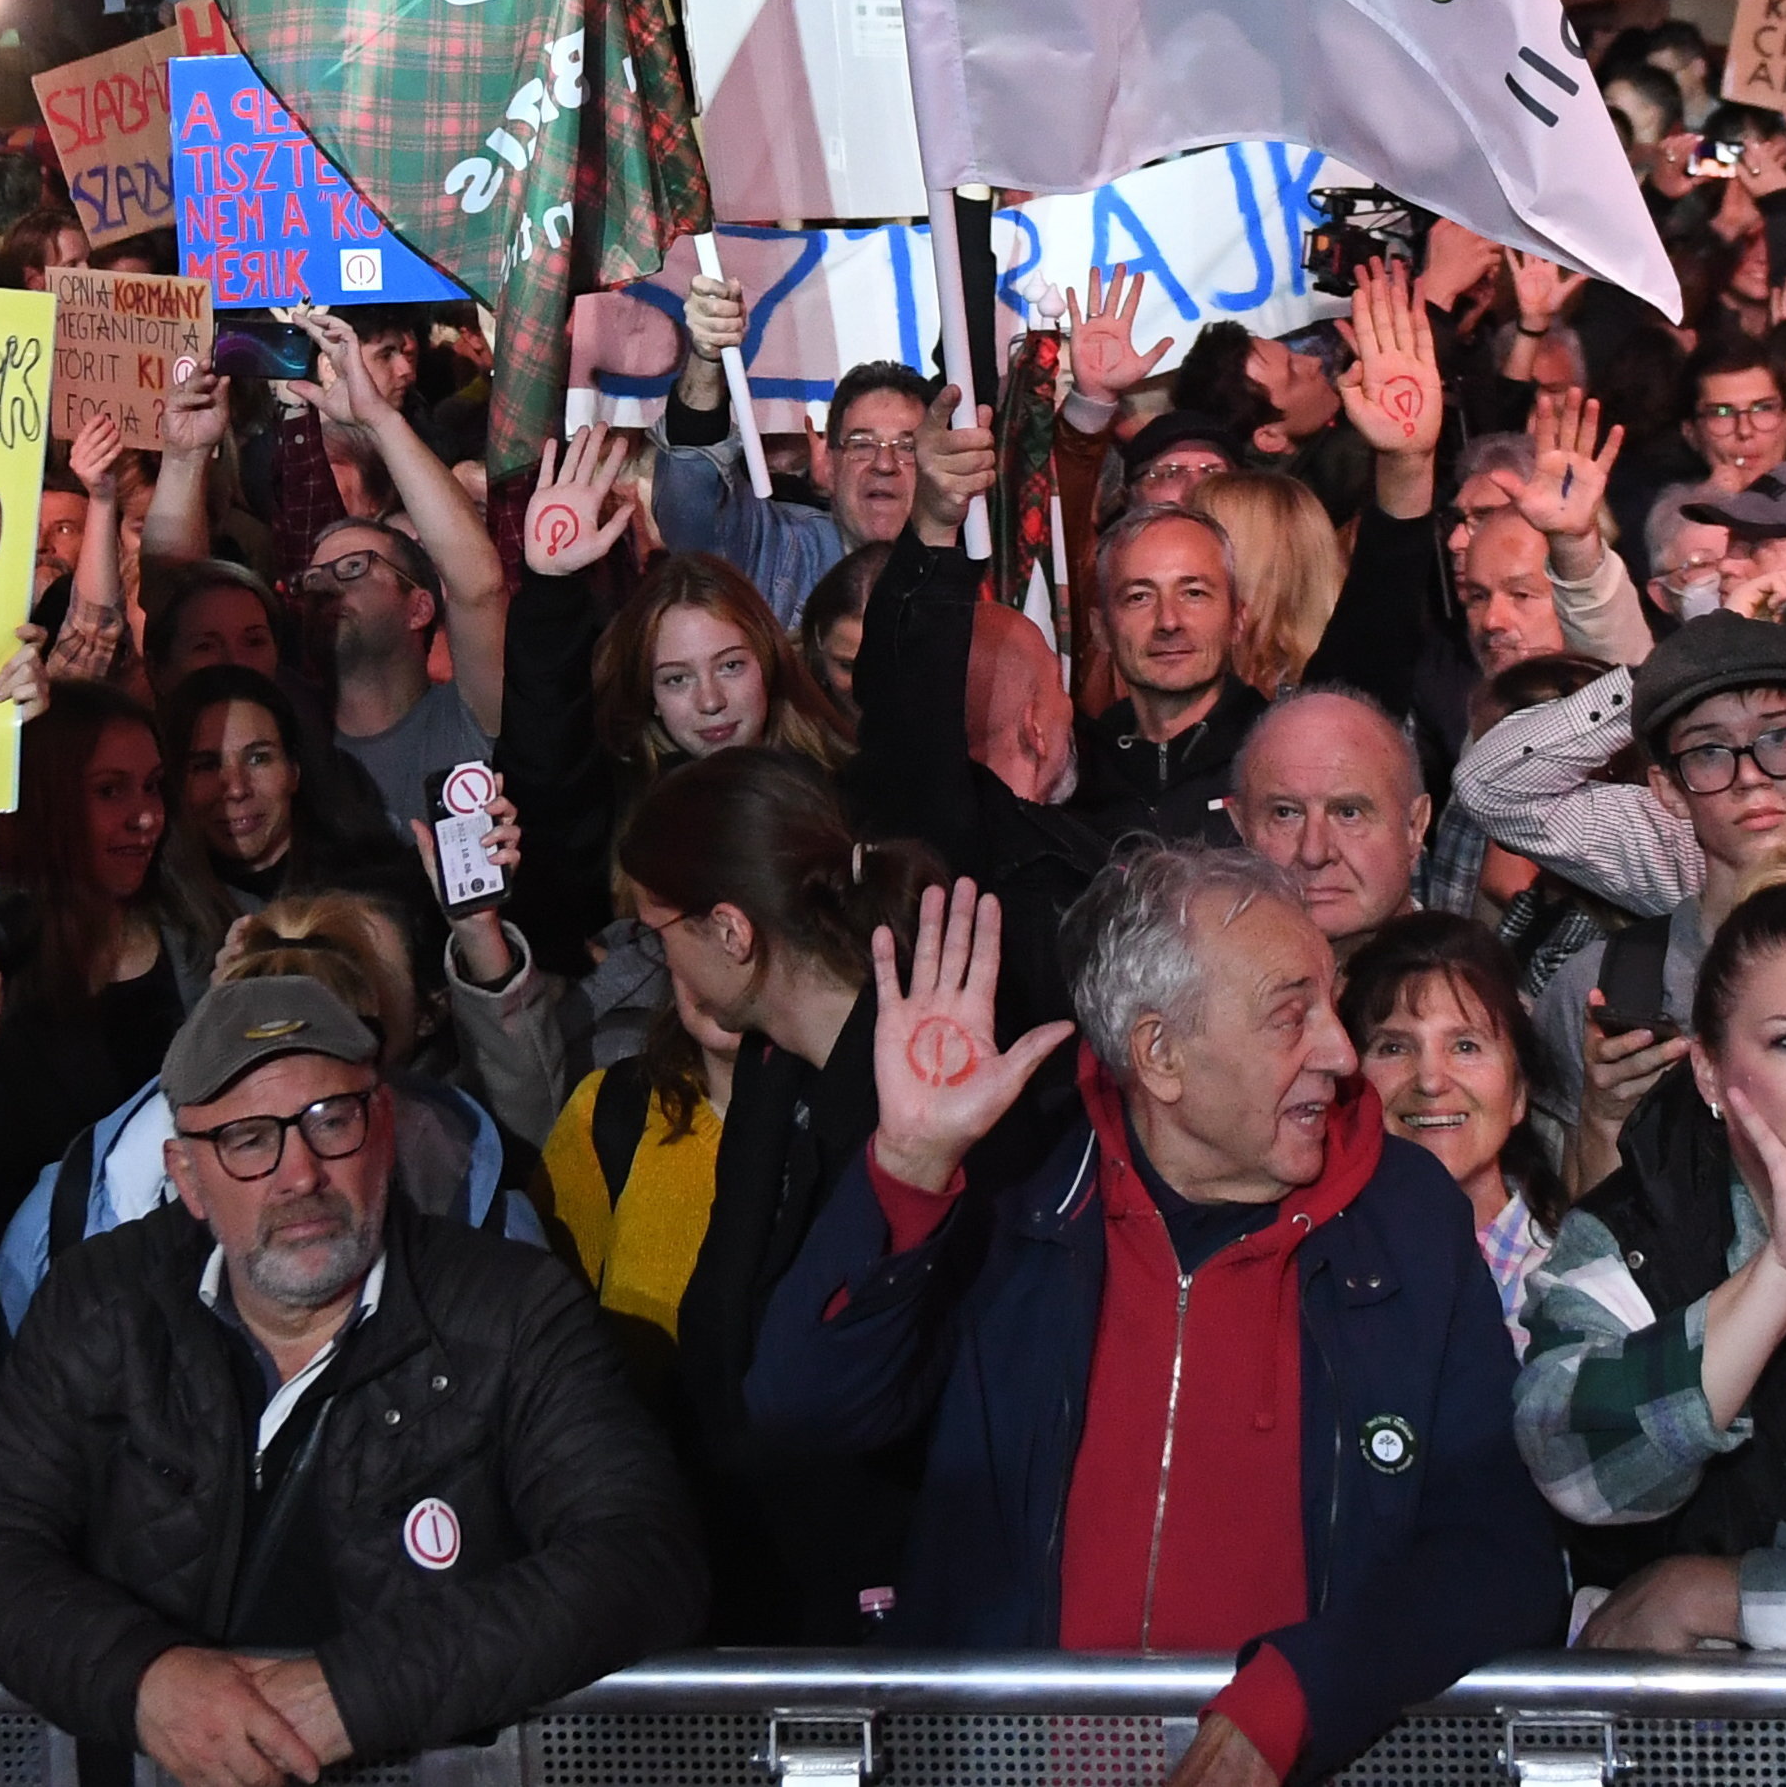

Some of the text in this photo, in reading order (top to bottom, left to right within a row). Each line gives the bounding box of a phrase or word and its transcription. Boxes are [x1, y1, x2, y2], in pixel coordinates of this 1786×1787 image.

[181, 91, 221, 140] A
[184, 191, 265, 248] NEM
[281, 192, 309, 238] A
[95, 278, 112, 310] A
[114, 278, 206, 320] KORMÁNY
[181, 323, 200, 353] A
[137, 354, 164, 390] KI
